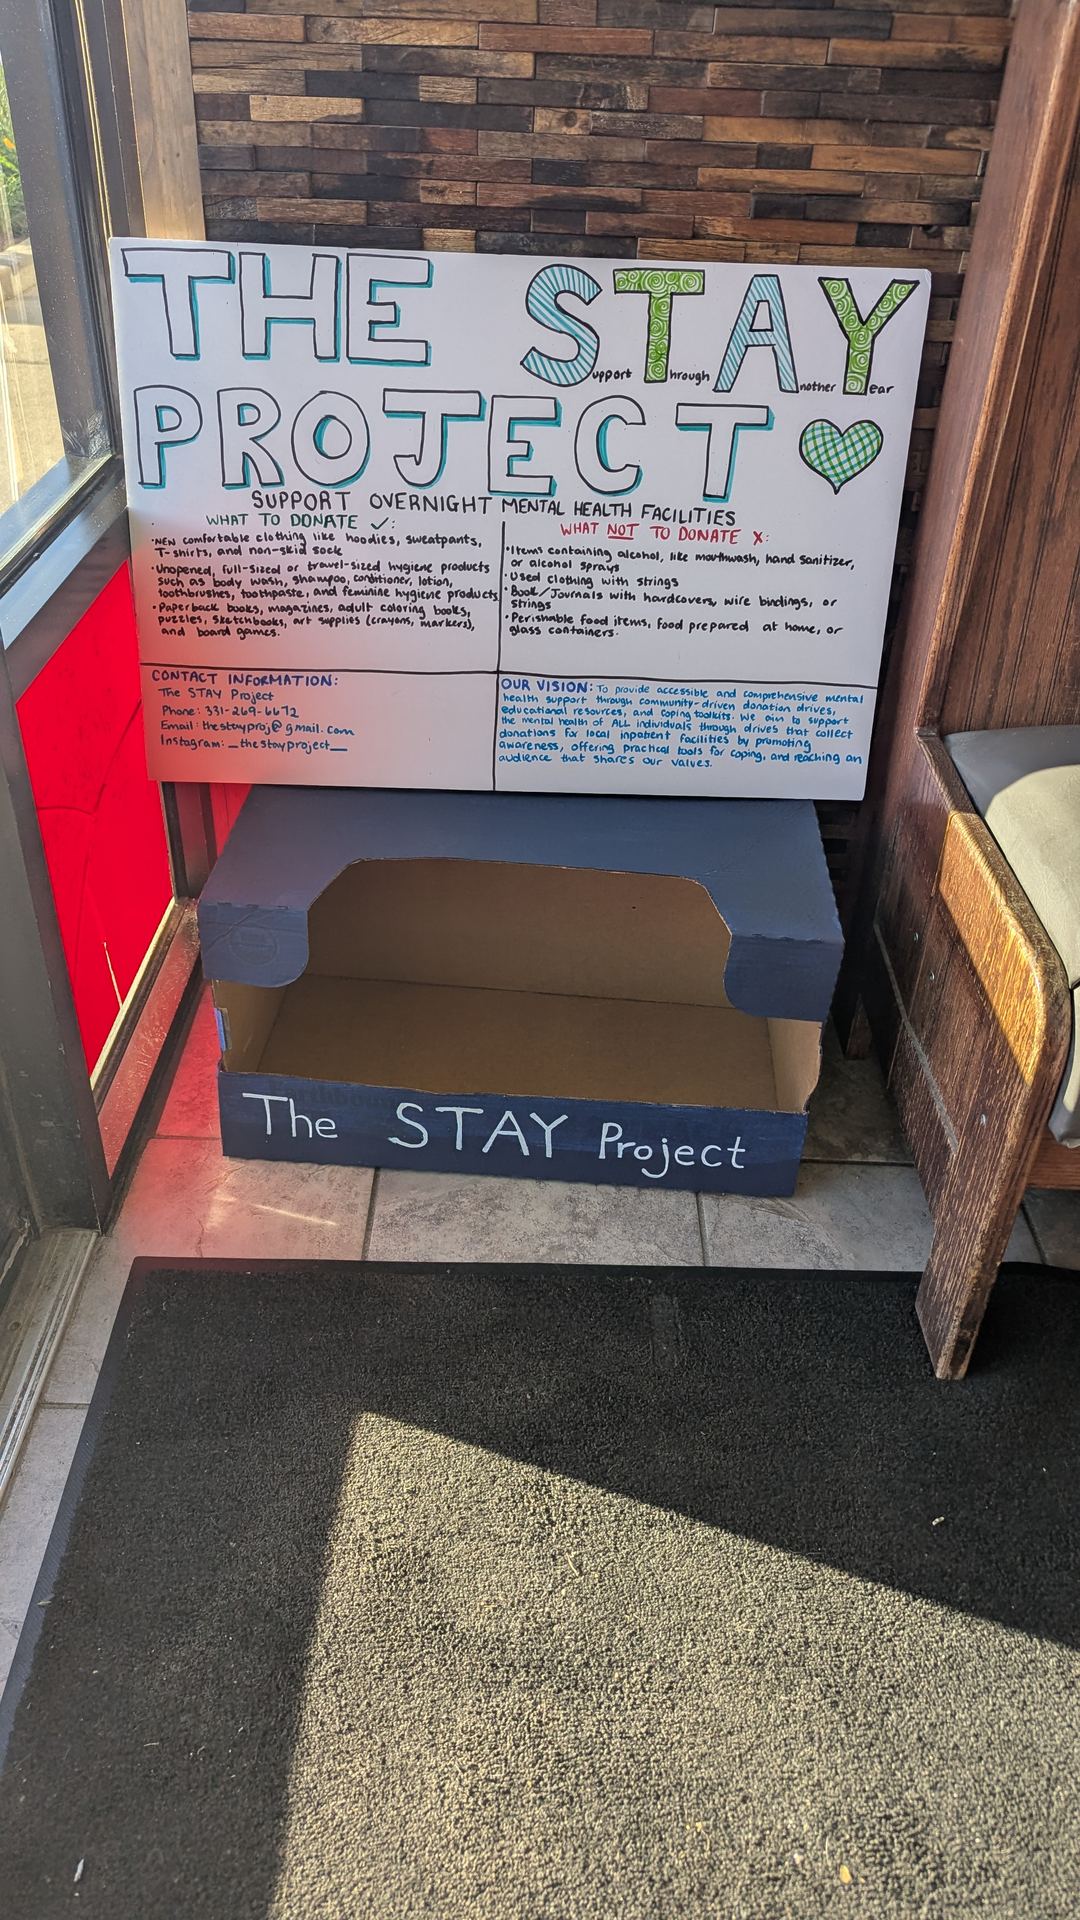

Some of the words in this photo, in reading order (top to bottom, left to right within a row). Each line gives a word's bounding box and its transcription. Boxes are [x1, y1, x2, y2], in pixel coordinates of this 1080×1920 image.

[122, 247, 434, 366] THE
[133, 385, 774, 502] PROJECT
[252, 490, 350, 510] SUPPORT
[370, 492, 492, 514] OVERNIGHT
[502, 498, 565, 515] MENTAL
[574, 501, 632, 517] HEALTH
[641, 504, 736, 526] FACILITIES
[206, 514, 248, 526] WHAT
[259, 513, 280, 526] TO
[291, 514, 358, 529] DONATE
[183, 534, 249, 544] comfortable
[256, 531, 306, 543] clothing
[313, 532, 335, 541] like
[346, 533, 400, 546] hoodies,
[406, 534, 482, 548] sweatpants,
[561, 522, 599, 536] WHAT
[608, 524, 640, 537] NOT
[650, 526, 670, 540] TO
[678, 526, 741, 544] DONATE
[155, 548, 212, 558] T-shirts,
[217, 546, 242, 556] and
[249, 543, 306, 555] non-skid
[312, 546, 342, 556] sock
[511, 546, 543, 554] Items
[548, 546, 612, 562] containing
[618, 550, 663, 562] alcohol,
[670, 553, 688, 562] like
[696, 552, 760, 566] mouthwash,
[766, 553, 795, 564] hand
[800, 554, 854, 570] sanitizer,
[156, 564, 215, 577] Unopened,
[223, 564, 280, 574] full-sized
[308, 559, 380, 571] travel-sized
[389, 562, 432, 574] hygiene
[441, 561, 490, 574] products
[530, 560, 572, 568] alcohol
[580, 562, 619, 573] sprays
[158, 578, 183, 587] such
[190, 578, 205, 586] as
[213, 578, 242, 589] body
[251, 577, 287, 587] wash,
[419, 577, 452, 588] lotion,
[510, 572, 540, 581] Used
[548, 576, 594, 589] clothing
[602, 577, 629, 586] with
[637, 577, 679, 589] strings
[158, 589, 235, 600] toothbrushes,
[241, 589, 309, 600] toothpaste,
[313, 586, 337, 596] and
[342, 586, 390, 597] feminine
[396, 588, 441, 602] hygiene
[448, 588, 498, 602] products
[610, 592, 636, 600] with
[644, 594, 717, 607] hardcovers,
[724, 595, 750, 606] wire
[759, 595, 812, 610] bindings,
[159, 603, 219, 612] Paperback
[268, 602, 333, 615] magazines,
[338, 602, 373, 613] adult
[380, 603, 426, 619] coloring
[434, 606, 470, 617] books,
[511, 600, 551, 611] strings
[213, 615, 287, 628] sketchbooks,
[318, 615, 360, 627] supplies
[366, 615, 414, 627] (crayons,
[421, 618, 474, 631] markers),
[510, 625, 541, 636] glass
[549, 625, 618, 637] containers.
[511, 612, 574, 624] Perishable
[581, 614, 608, 625] food
[614, 615, 650, 628] items,
[657, 618, 682, 629] food
[689, 620, 749, 633] prepared
[763, 621, 778, 631] at
[785, 622, 820, 635] home,
[161, 627, 185, 636] and
[198, 627, 231, 636] board
[237, 628, 280, 640] games.
[152, 670, 217, 684] CONTACT
[228, 675, 338, 686] INFORMATION:
[159, 688, 180, 697] The
[188, 689, 221, 698] STAY
[231, 689, 274, 704] Project
[501, 678, 530, 691] OUR
[537, 680, 593, 693] VISION:
[597, 685, 608, 693] To
[615, 685, 650, 698] provide
[657, 688, 709, 698] accessible
[717, 689, 736, 698] and
[743, 690, 818, 704] comprehensive
[826, 694, 863, 703] mental
[162, 706, 200, 716] Phone:
[205, 706, 298, 718] 331-269-6672
[503, 694, 538, 702] health
[546, 696, 587, 706] support
[596, 696, 632, 707] through
[743, 701, 791, 713] donation
[797, 704, 835, 716] drives,
[501, 706, 567, 714] educational
[573, 709, 626, 717] resources,
[633, 709, 653, 717] and
[661, 709, 691, 721] coping
[808, 717, 848, 727] support
[161, 721, 198, 730] Email:
[559, 718, 587, 726] health
[593, 718, 603, 726] of
[612, 719, 630, 728] ALL
[637, 720, 692, 730] individuals
[699, 722, 736, 735] through
[744, 724, 778, 733] drives
[786, 726, 809, 737] that
[816, 728, 853, 738] collect
[161, 736, 224, 750] Instagram:
[499, 729, 556, 738] donations
[565, 728, 577, 737] for
[586, 730, 610, 738] local
[680, 733, 729, 744] facilities
[738, 736, 749, 747] by
[755, 738, 811, 753] promoting
[499, 754, 552, 762] audience
[561, 754, 585, 763] that
[593, 755, 634, 764] shares
[643, 757, 662, 766] our
[672, 758, 712, 768] values.
[500, 741, 563, 752] awareness,
[571, 742, 614, 754] offering
[623, 744, 669, 754] practical
[678, 747, 702, 755] tools
[710, 746, 723, 756] for
[731, 750, 766, 763] coping,
[771, 752, 789, 761] and
[846, 754, 862, 764] an
[242, 1092, 338, 1139] The
[388, 1102, 568, 1158] STAY
[598, 1122, 746, 1179] Project
